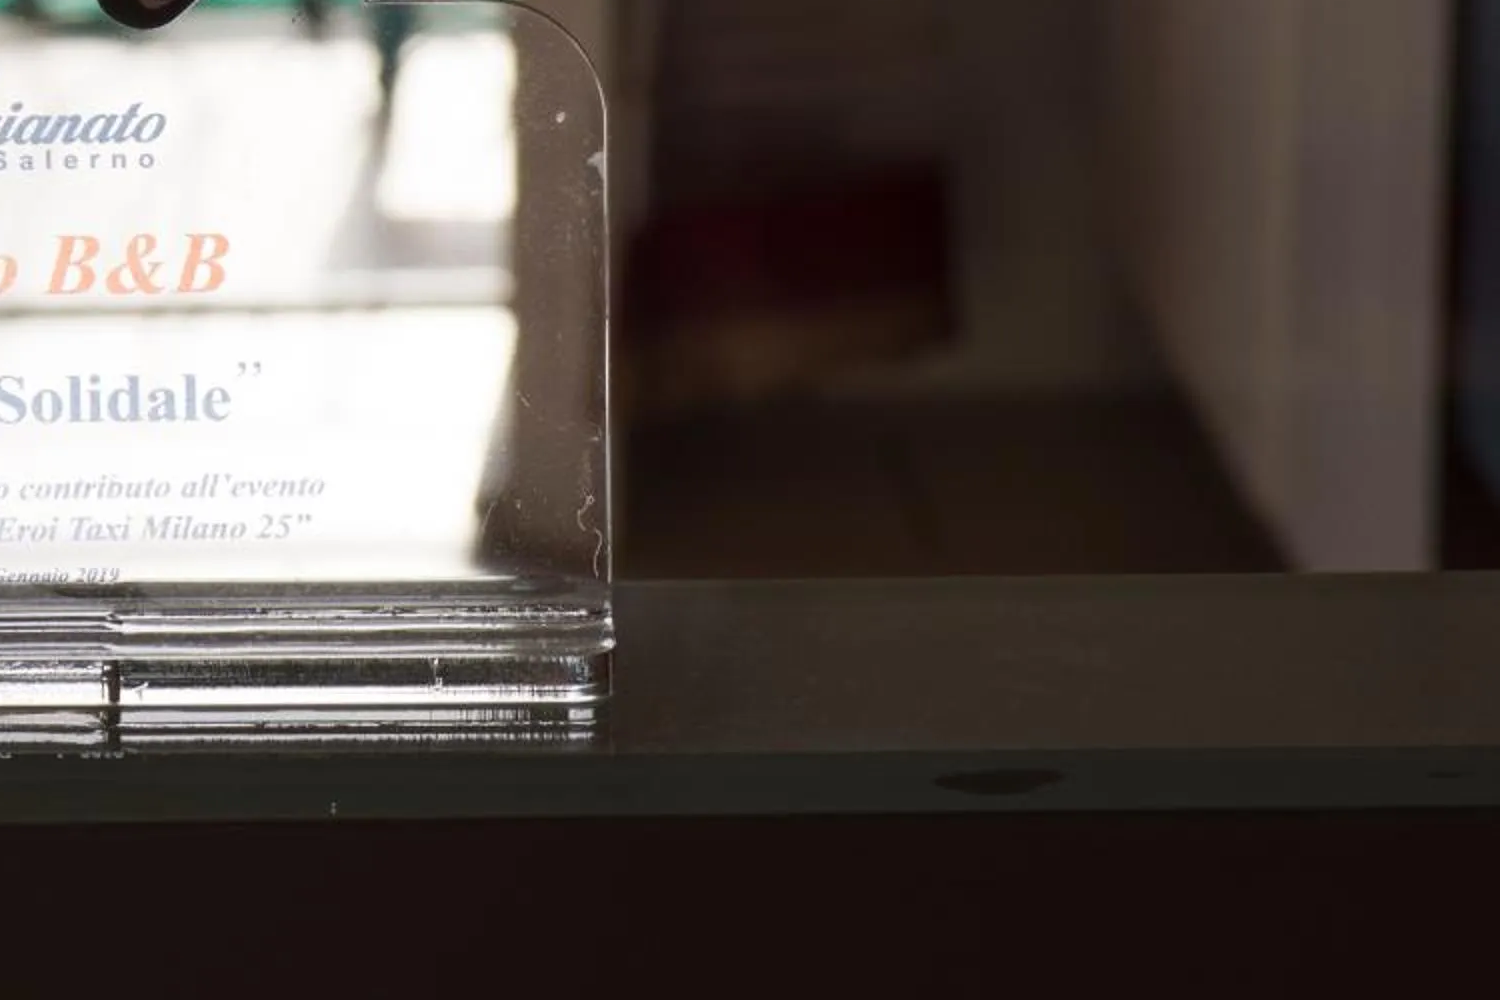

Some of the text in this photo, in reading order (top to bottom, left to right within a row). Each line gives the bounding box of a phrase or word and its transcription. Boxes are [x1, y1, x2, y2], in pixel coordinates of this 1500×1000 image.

[44, 232, 231, 295] B&B
[19, 473, 171, 500] contributo
[69, 515, 134, 542] Taxi
[142, 513, 248, 541] Milano
[73, 565, 122, 583] 2019
